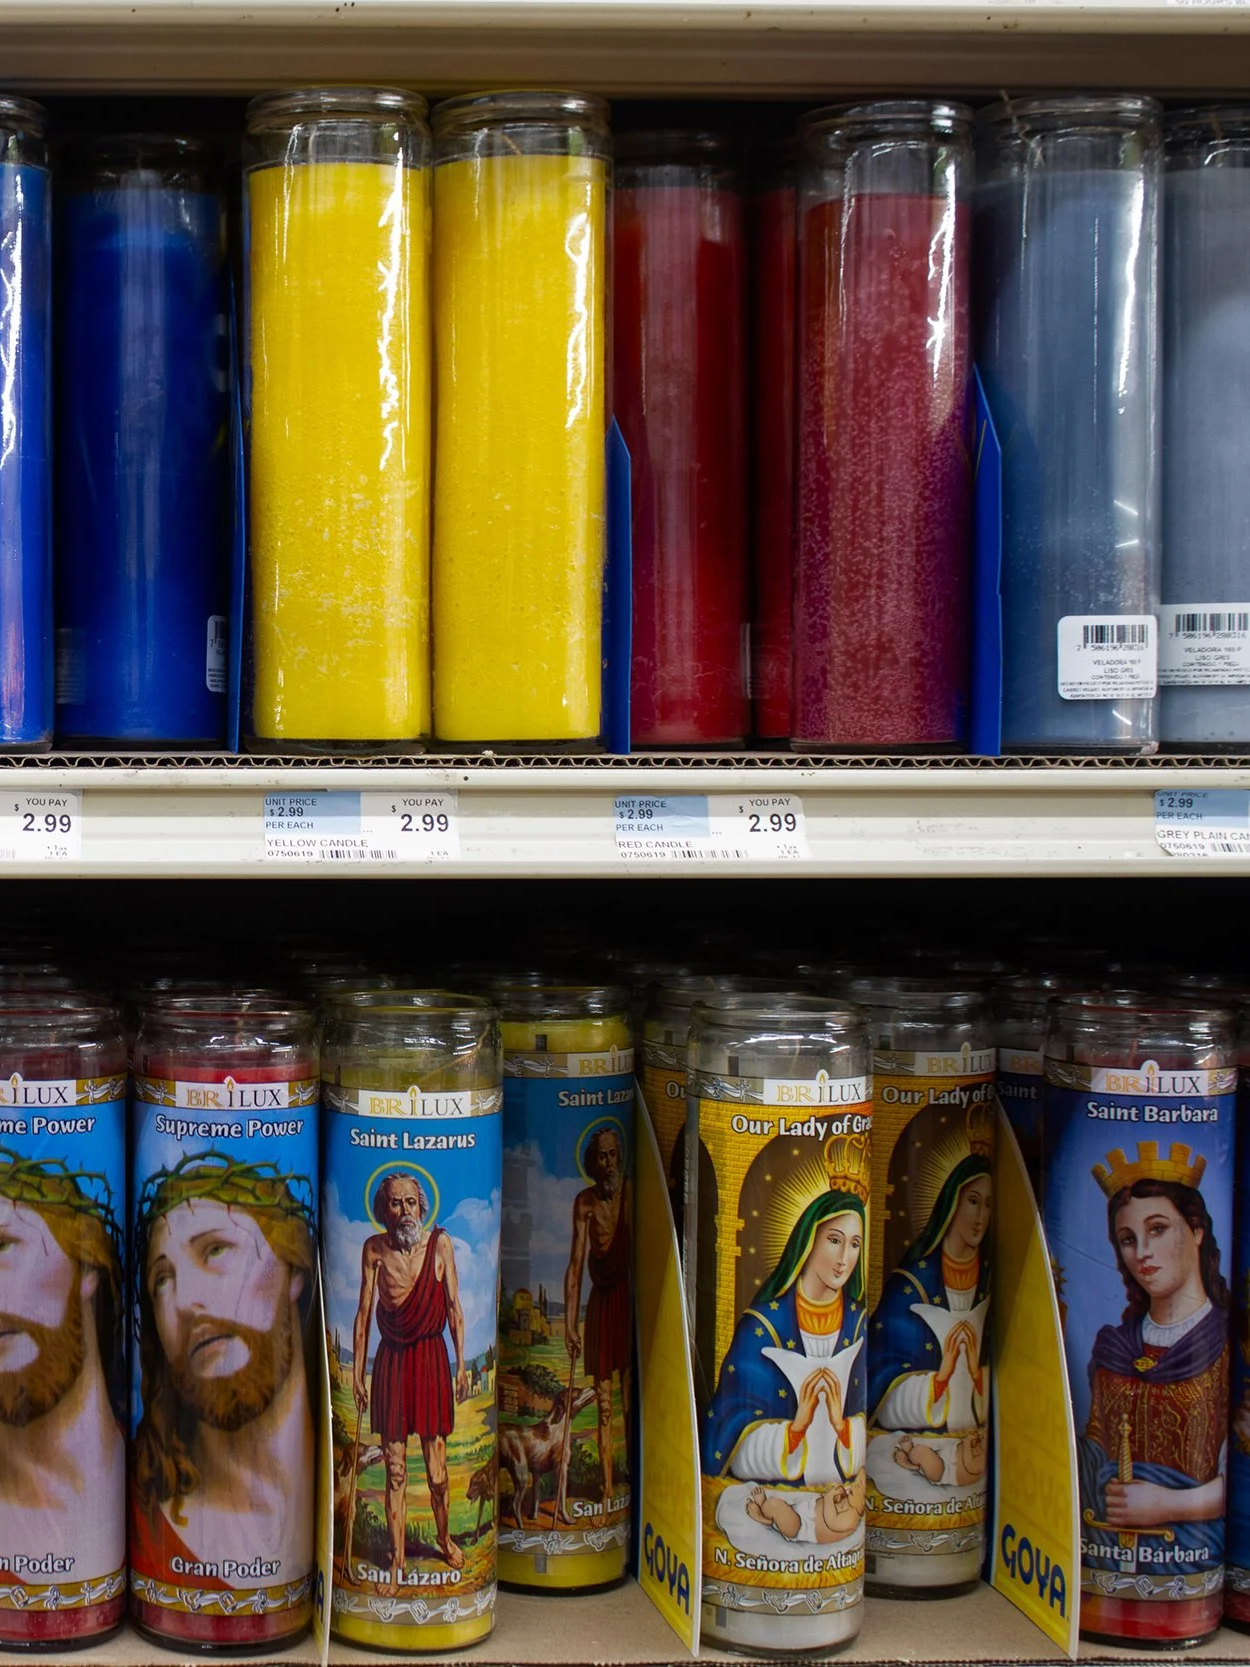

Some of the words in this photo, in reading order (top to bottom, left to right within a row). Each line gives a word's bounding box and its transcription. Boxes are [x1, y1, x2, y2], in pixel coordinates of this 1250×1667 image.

[26, 798, 46, 806] YOU
[48, 799, 67, 807] PAY
[265, 798, 287, 806] UNIT
[290, 798, 317, 806] PRICE
[402, 799, 422, 807] YOU
[425, 799, 444, 807] PAY
[615, 800, 637, 808] UNIT
[639, 800, 666, 808] PRICE
[749, 799, 769, 807] YOU
[772, 798, 791, 806] PAY
[265, 821, 284, 829] PER
[287, 821, 314, 829] EACH
[1177, 812, 1202, 820] EACH
[616, 824, 634, 832] PER
[1158, 830, 1189, 839] GREY
[1194, 831, 1226, 840] PLAIN
[267, 839, 316, 847] YELLOW
[320, 839, 368, 847] CANDLE
[645, 841, 693, 849] CANDLE
[558, 1088, 604, 1107] Saint
[882, 1086, 923, 1104] Our
[928, 1086, 970, 1109] Lady
[972, 1083, 987, 1103] of
[1087, 1101, 1139, 1121] Saint
[1144, 1104, 1218, 1124] Barbara
[31, 1116, 95, 1135] Power
[155, 1114, 242, 1141] Supreme
[246, 1119, 304, 1138] Power
[732, 1114, 773, 1135] Our
[779, 1116, 828, 1142] Lady
[831, 1114, 850, 1135] of
[350, 1128, 398, 1149] Saint
[402, 1132, 476, 1150] Lazarus
[573, 1501, 603, 1517] San
[883, 1499, 942, 1515] Señora
[946, 1496, 962, 1514] de
[14, 1553, 75, 1573] Poder
[714, 1547, 732, 1565] N.
[735, 1552, 799, 1573] Señora
[803, 1554, 824, 1572] de
[826, 1549, 863, 1571] Altagr
[1138, 1545, 1209, 1564] Bárbara
[170, 1556, 218, 1577] Gran
[222, 1557, 280, 1578] Poder
[356, 1563, 392, 1584] San
[396, 1568, 461, 1586] Lázaro
[643, 1522, 691, 1616] GOYA
[1001, 1523, 1066, 1617] GOYA
